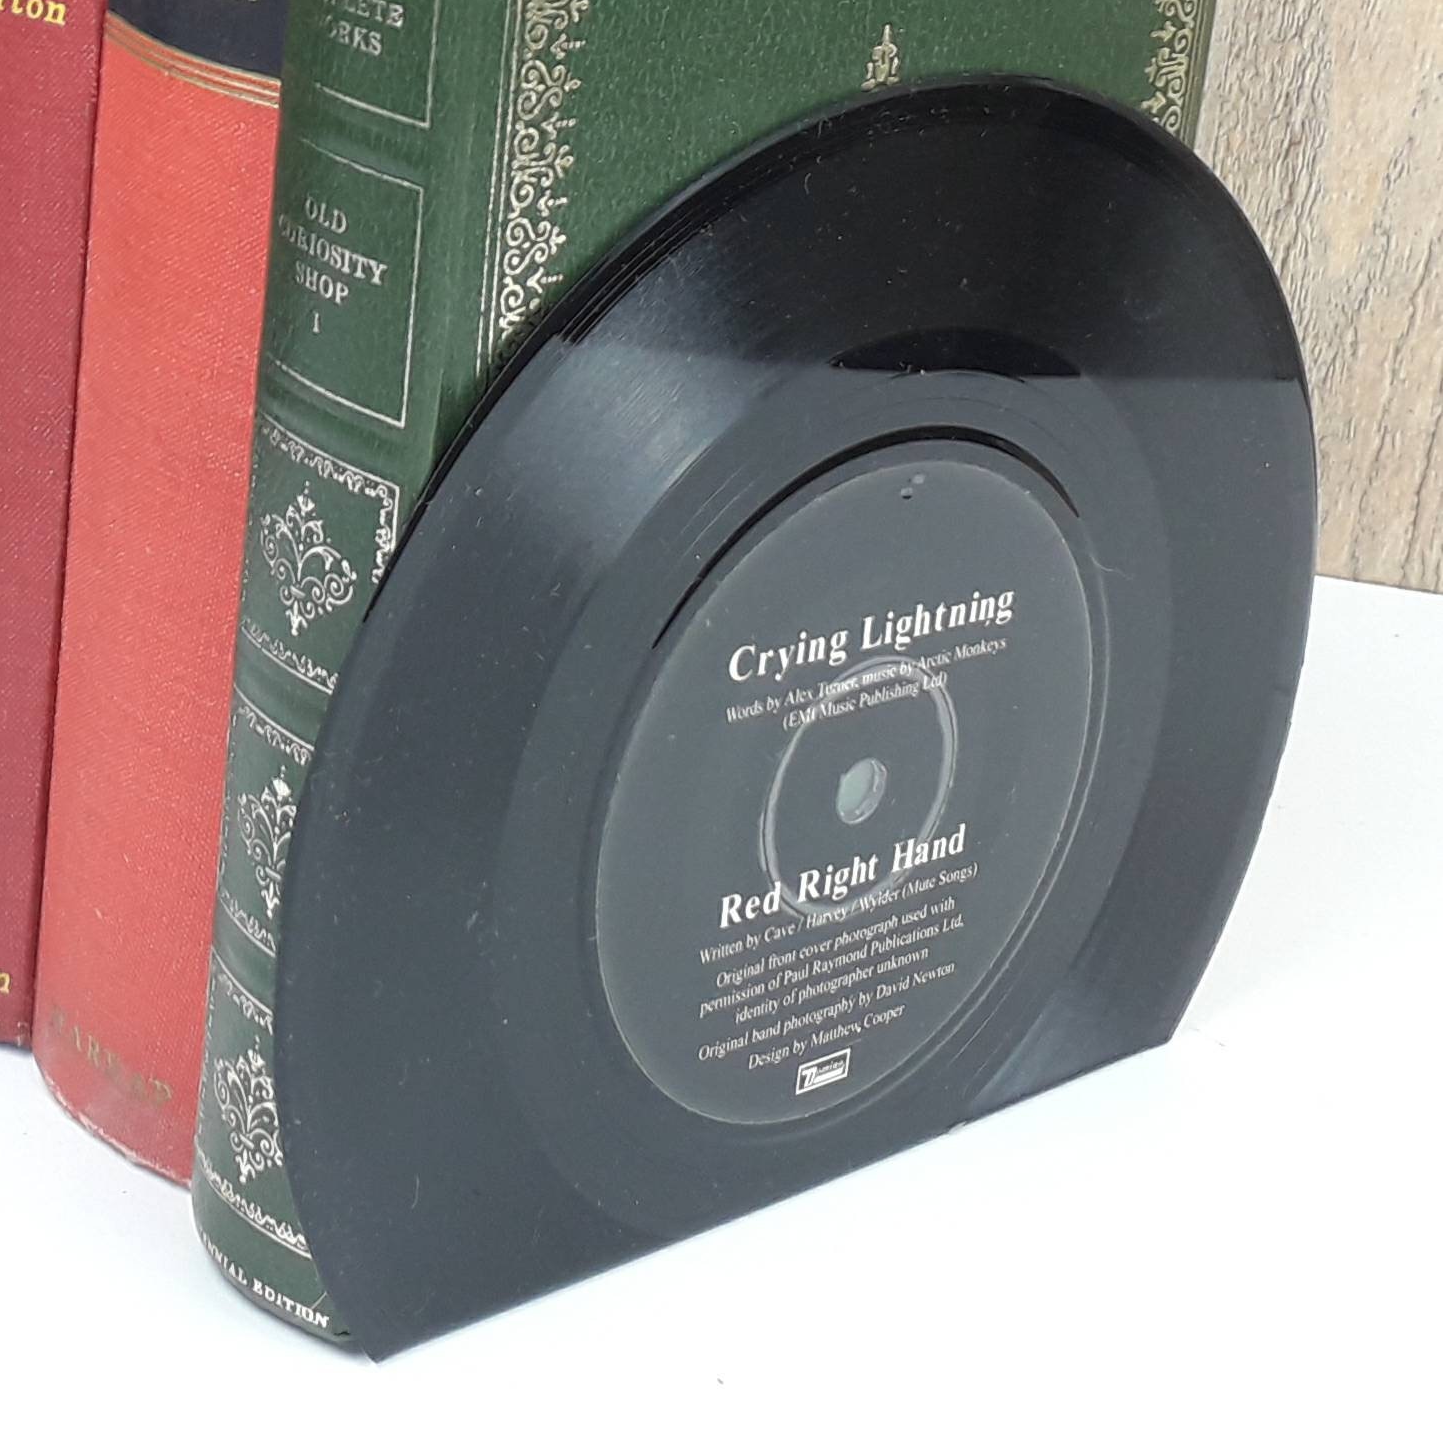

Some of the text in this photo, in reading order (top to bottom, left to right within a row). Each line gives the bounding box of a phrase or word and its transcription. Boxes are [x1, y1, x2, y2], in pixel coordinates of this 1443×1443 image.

[306, 196, 347, 234] OLD
[295, 260, 349, 305] SHOP
[729, 591, 1014, 681] Crying Lightning
[727, 700, 763, 723] Words
[766, 695, 781, 713] by
[784, 688, 813, 706] Alex
[862, 665, 897, 685] music
[899, 661, 915, 677] by
[919, 650, 952, 669] Arctic
[953, 638, 1007, 660] Monkeys
[782, 707, 817, 731] (EMI
[820, 698, 856, 718] Music
[859, 681, 919, 708] Publishing
[699, 939, 743, 964] Written
[746, 934, 761, 950] by
[764, 923, 796, 943] Cave
[806, 907, 846, 928] Harvey
[902, 879, 936, 900] (Mute
[938, 862, 978, 886] Songs)
[720, 823, 966, 928] Red Right Hand
[700, 914, 964, 1018] permission of Paul Raymond Publications Ltd.
[717, 896, 955, 987] Original front cover photograph used with
[699, 962, 955, 1061] Original band photography by David Newton
[736, 947, 929, 1024] identity of photographer unknown
[749, 1004, 906, 1070] Design by Matthew Cooper
[253, 1278, 330, 1328] EDITION
